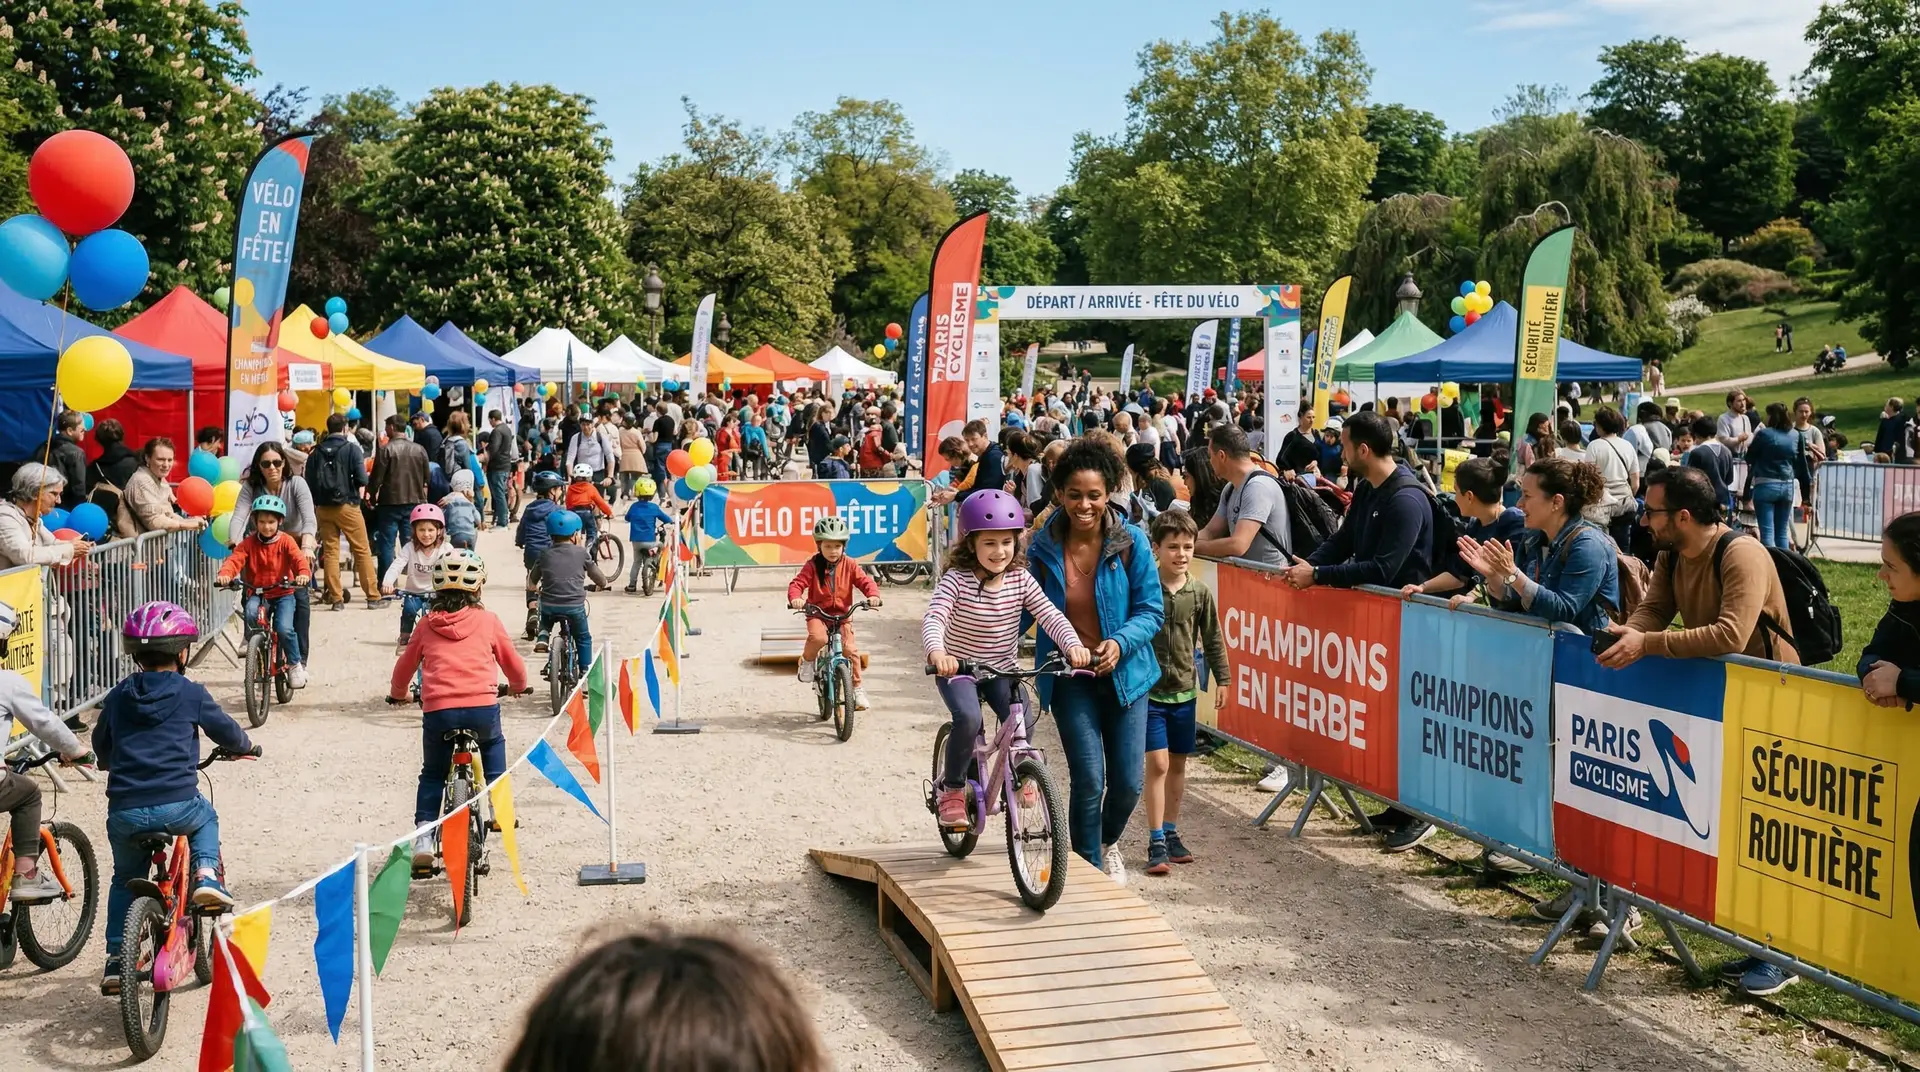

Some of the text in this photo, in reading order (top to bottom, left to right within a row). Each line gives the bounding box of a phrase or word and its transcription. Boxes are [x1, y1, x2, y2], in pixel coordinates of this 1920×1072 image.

[253, 178, 295, 208] VÉLO
[241, 232, 290, 263] FÊTE!
[259, 210, 281, 234] EN
[1027, 292, 1076, 309] DÉPART
[1079, 295, 1084, 309] /
[1088, 292, 1142, 309] ARRIVÉE
[1154, 291, 1183, 308] FÊTE
[1187, 294, 1204, 308] DU
[1208, 291, 1239, 308] VÉLO
[1542, 291, 1559, 344] ROUTIÈRE
[950, 287, 969, 374] CYCLISME
[1523, 320, 1541, 373] SÉCURITÉ
[734, 501, 792, 537] VÉLO
[1, 641, 34, 670] OUTIÈRE
[1224, 606, 1388, 692] CHAMPIONS
[1237, 664, 1367, 750] EN HERBE
[1411, 670, 1534, 739] CHAMPIONS
[1422, 717, 1523, 784] EN HERBE
[1572, 714, 1641, 763] PARIS
[1574, 760, 1650, 801] CYCLISME
[1751, 740, 1885, 827] SÉCURITÉ
[1748, 812, 1882, 901] ROUTIÈRE
